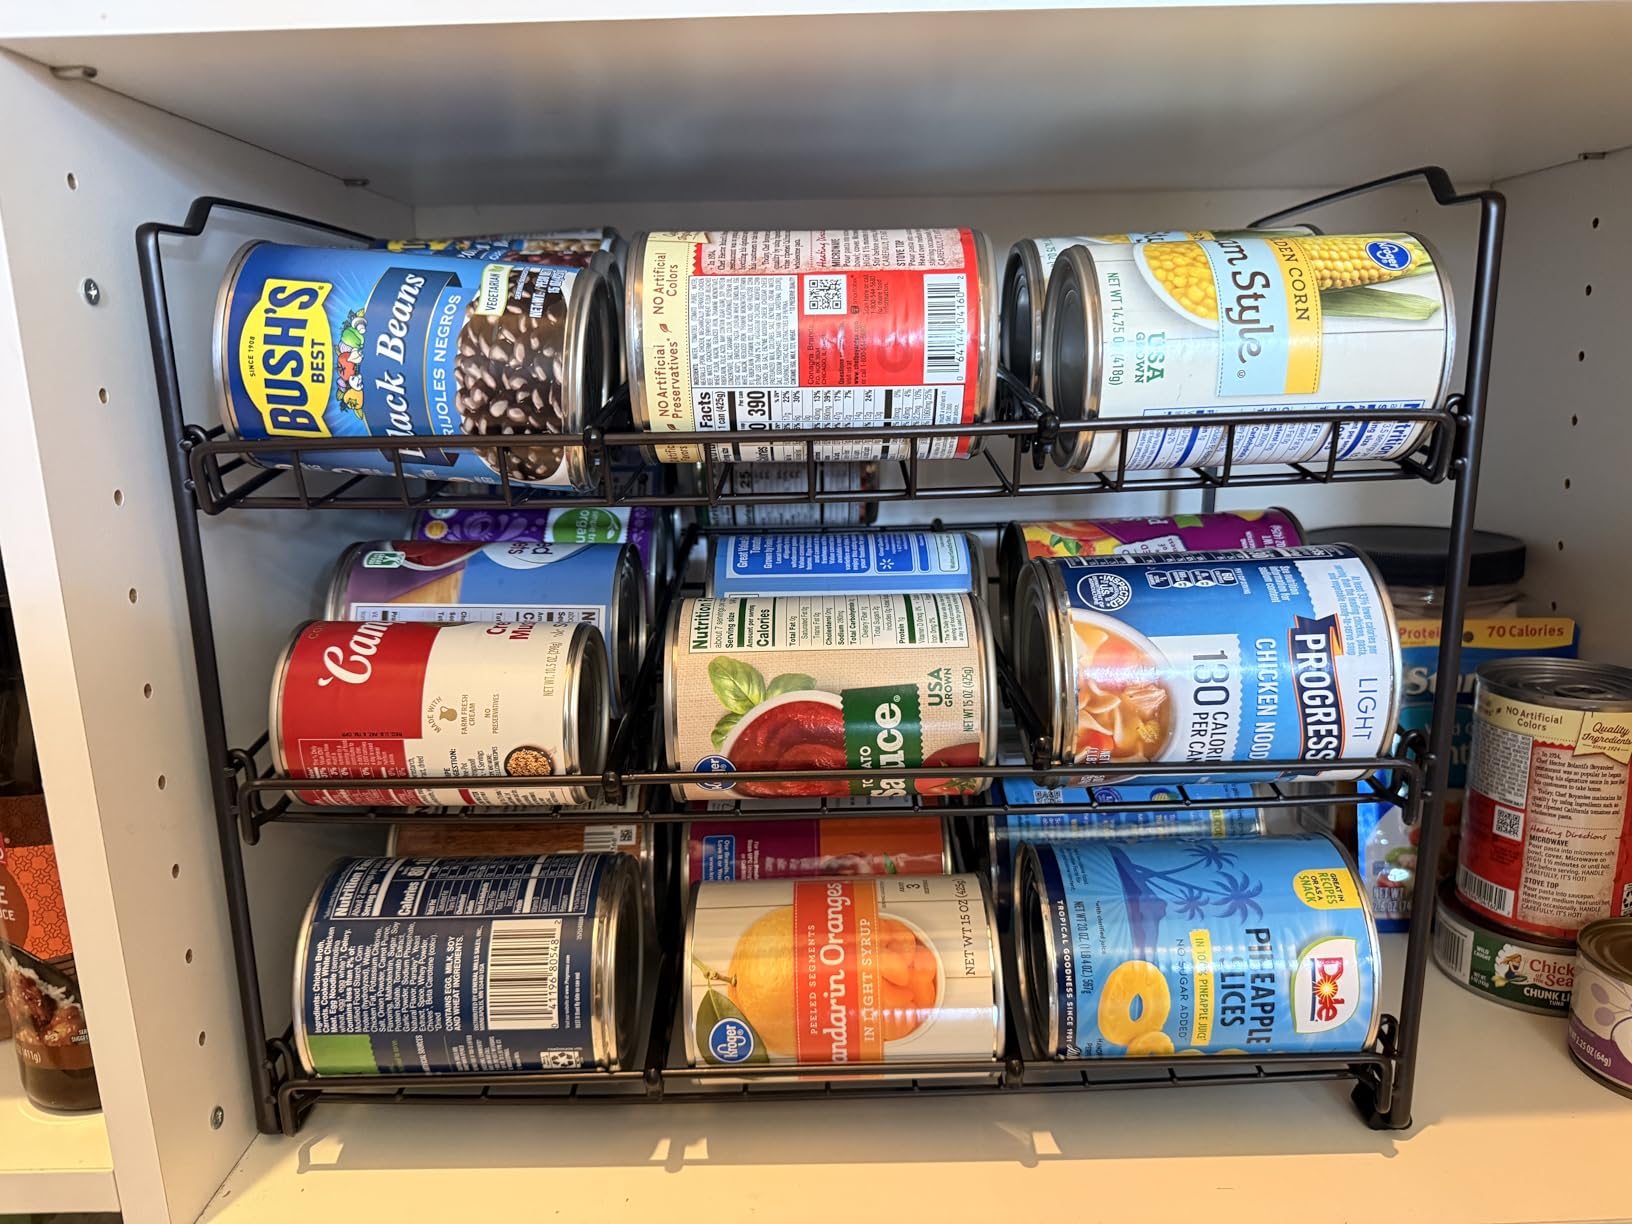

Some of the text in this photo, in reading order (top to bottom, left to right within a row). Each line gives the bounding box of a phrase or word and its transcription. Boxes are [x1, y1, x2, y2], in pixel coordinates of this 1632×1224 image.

[1376, 242, 1398, 268] Kroger
[484, 273, 500, 311] VEGETARIAN
[652, 252, 666, 315] NO Artificial
[665, 264, 678, 297] Colors
[1288, 267, 1310, 321] CORN
[375, 273, 425, 365] Beans
[956, 292, 964, 324] 04160
[1225, 271, 1274, 364] Style
[1107, 272, 1125, 386] NET WT 14.75 (418g)
[248, 335, 256, 377] SINCE 1908
[262, 285, 322, 432] BUSH'S
[310, 338, 326, 384] BEST
[432, 294, 462, 436] RIJOLES NEGROS
[1134, 332, 1145, 384] GOWN
[1146, 332, 1164, 383] USA
[652, 344, 670, 417] NO Artificial
[698, 392, 713, 428] Facts
[746, 390, 766, 416] 390
[1102, 574, 1126, 608] INSPECTED
[692, 602, 712, 649] Nutrition
[725, 612, 736, 648] Serving size
[756, 609, 770, 647] Calories
[898, 623, 906, 644] Protein
[1486, 626, 1506, 638] 70
[1508, 626, 1564, 638] Calories
[544, 655, 558, 685] WT. 10.5 OZ
[928, 668, 943, 707] USA
[944, 668, 954, 708] GROWN
[1192, 650, 1230, 706] 130
[427, 696, 443, 733] MADE WITH
[484, 708, 492, 718] NO
[492, 694, 500, 734] PRESERVATIVES
[962, 666, 976, 732] NET WT OZ (425g)
[1248, 638, 1278, 761] CHICKEN NOOD
[1294, 633, 1338, 760] PROGRESS
[1352, 678, 1378, 740] LIGHT
[1190, 712, 1209, 738] PER
[1506, 706, 1563, 725] NO Artificial
[1516, 718, 1546, 731] Colors
[1592, 722, 1630, 738] Quality
[1205, 711, 1229, 761] CALORI
[1582, 733, 1632, 746] Ingredients
[1528, 834, 1568, 848] MICROWAVE
[1530, 824, 1607, 842] Heating Directions
[1543, 845, 1559, 855] pasta
[1524, 868, 1558, 880] CAREFULLY,
[1554, 860, 1578, 869] minutes
[1564, 855, 1599, 864] Microwave
[1580, 868, 1603, 876] HANDLE
[334, 872, 362, 916] Nutrition
[397, 882, 420, 916] Calories
[1298, 875, 1316, 903] SNACK
[1310, 875, 1321, 894] OR AS
[1318, 872, 1338, 904] RECIPES
[1330, 873, 1345, 902] GREAT IN
[1524, 876, 1558, 890] STOVE TOP
[1538, 887, 1553, 898] pasta
[1550, 895, 1572, 906] medium
[1074, 900, 1086, 911] NET
[1075, 912, 1087, 922] WT
[1520, 902, 1554, 916] CAREFULLY,
[952, 880, 976, 976] NET WT 15 OZ (425g)
[321, 927, 336, 1006] Cooked White Chicken
[1056, 900, 1074, 1026] TROPICAL GOODNESS SINCE
[1176, 938, 1188, 1000] NO SUGAR
[1476, 946, 1489, 956] WILD
[1530, 959, 1576, 978] Chick
[377, 948, 388, 1018] Onion Carrot
[394, 960, 402, 984] Tomato
[446, 936, 456, 1031] CONTAINS SOY
[453, 936, 464, 1031] AND WHEAT INGREDIENTS.
[548, 939, 560, 1010] 41196 80548
[808, 924, 819, 1035] PEELED SEGMENTS
[820, 882, 851, 1063] andarin Oranges
[860, 919, 875, 1041] IN LIGHT SYRUP
[1316, 956, 1345, 1022] Dole
[1544, 974, 1574, 988] Sea
[314, 963, 323, 1033] Ingredients: Chicken
[329, 974, 338, 1015] Egg Noodle
[345, 970, 354, 1033] Contains than
[353, 988, 361, 1006] Food
[369, 957, 378, 1033] Chicken Potassium
[1197, 978, 1209, 1020] PINEAPPLE
[1219, 956, 1246, 1027] LICES
[1523, 987, 1560, 1002] CHUNK
[1549, 1000, 1565, 1008] TUNA
[361, 1010, 370, 1032] Protein
[23, 1046, 42, 1064] (411g)
[716, 1025, 746, 1058] Kroger
[1576, 1036, 1595, 1058] 2.25 OZ
